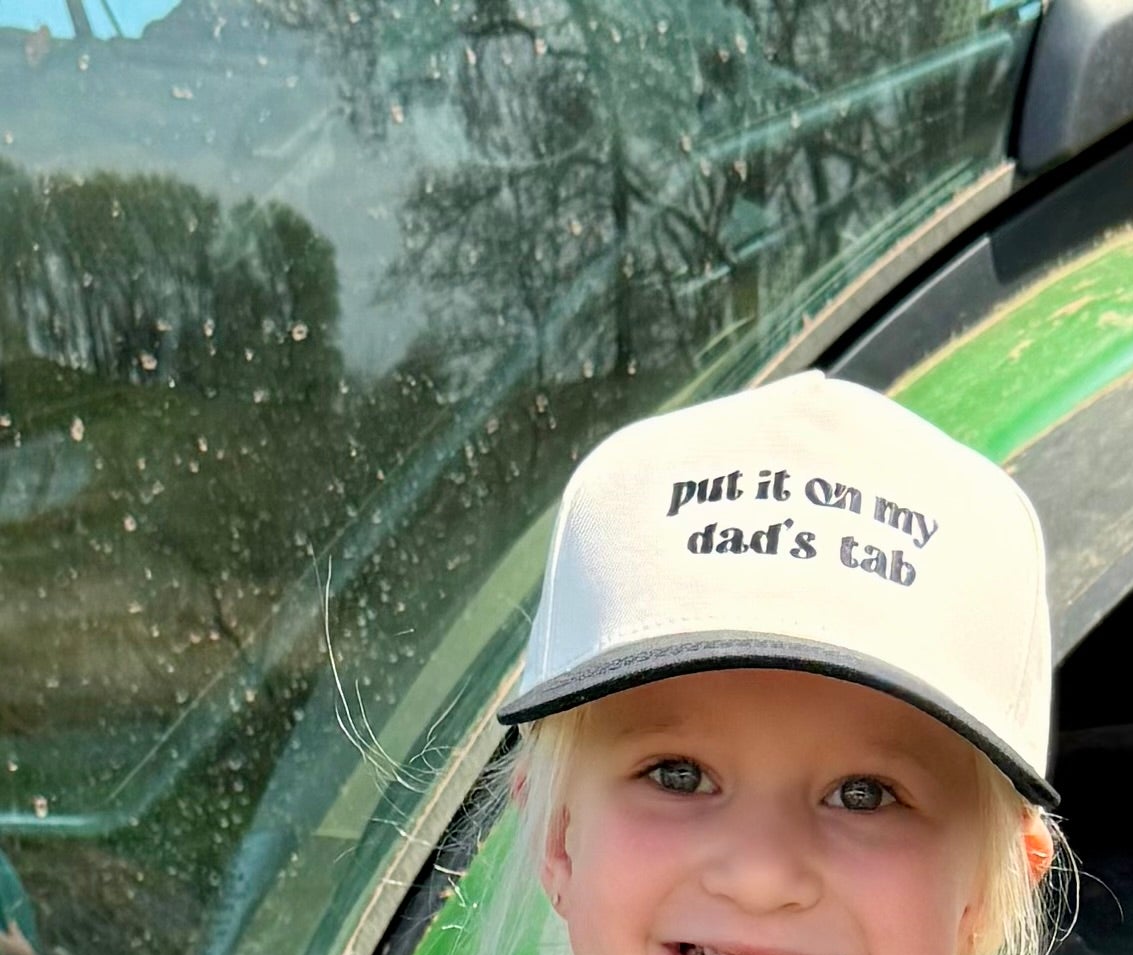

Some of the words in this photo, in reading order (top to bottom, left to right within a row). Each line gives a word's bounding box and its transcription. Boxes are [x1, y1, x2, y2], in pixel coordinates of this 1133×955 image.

[666, 470, 744, 517] put
[755, 470, 792, 502] it
[804, 477, 863, 515] on
[873, 495, 939, 549] my
[687, 518, 817, 559] dad's
[839, 535, 917, 587] tab
